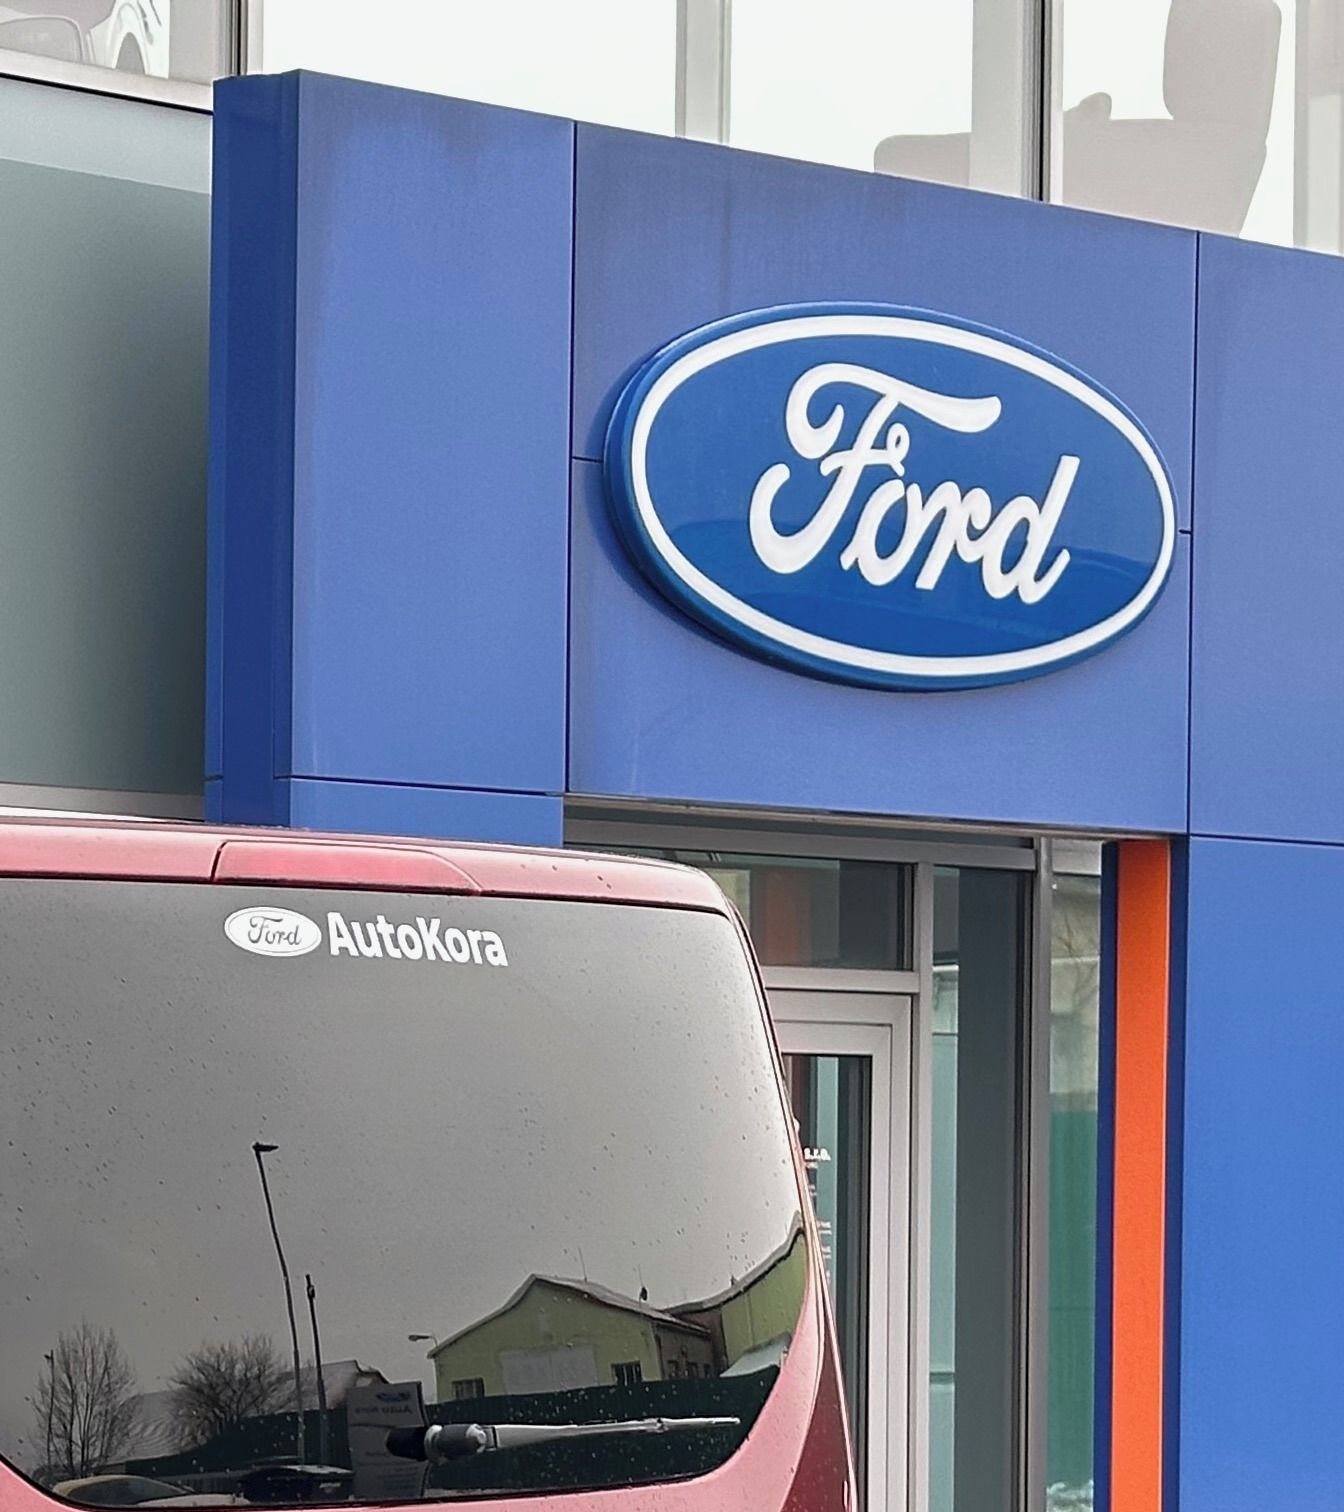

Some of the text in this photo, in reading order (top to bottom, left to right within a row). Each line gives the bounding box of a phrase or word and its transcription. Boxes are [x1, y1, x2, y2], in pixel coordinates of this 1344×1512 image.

[749, 362, 1080, 604] Ford
[247, 911, 509, 967] Ford AutoKora
